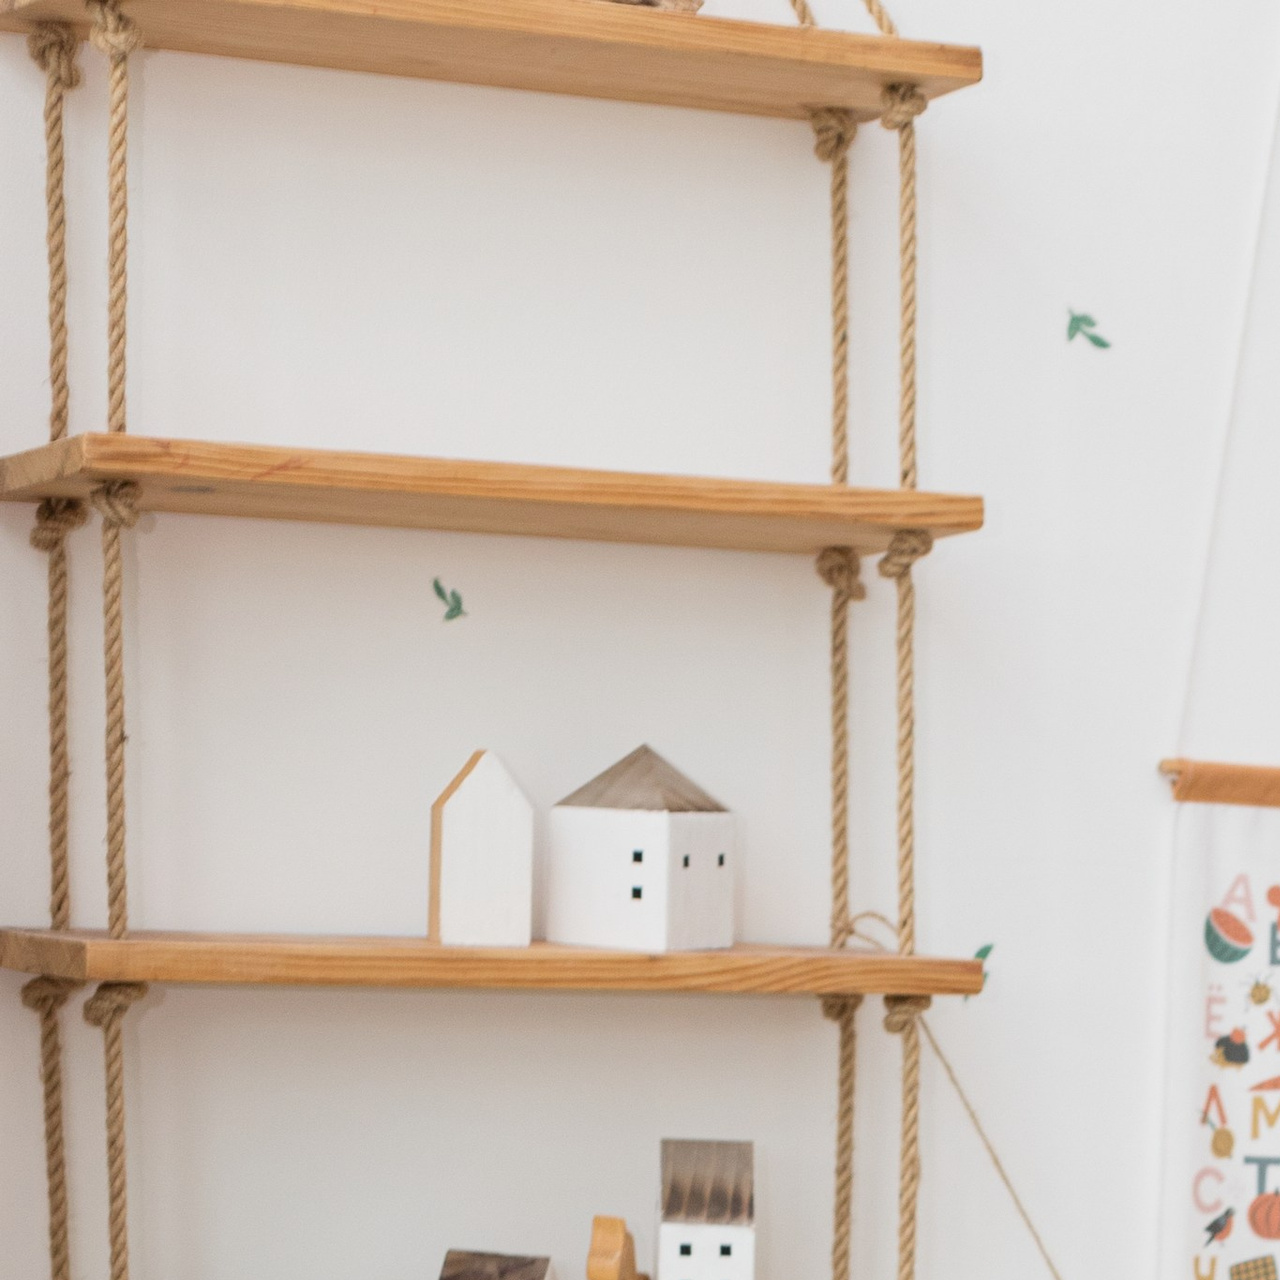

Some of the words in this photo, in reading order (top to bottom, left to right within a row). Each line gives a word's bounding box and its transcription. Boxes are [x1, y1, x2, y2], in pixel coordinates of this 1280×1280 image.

[1205, 983, 1226, 1038] Ё
[1201, 1083, 1227, 1125] Л
[1193, 1166, 1224, 1213] С
